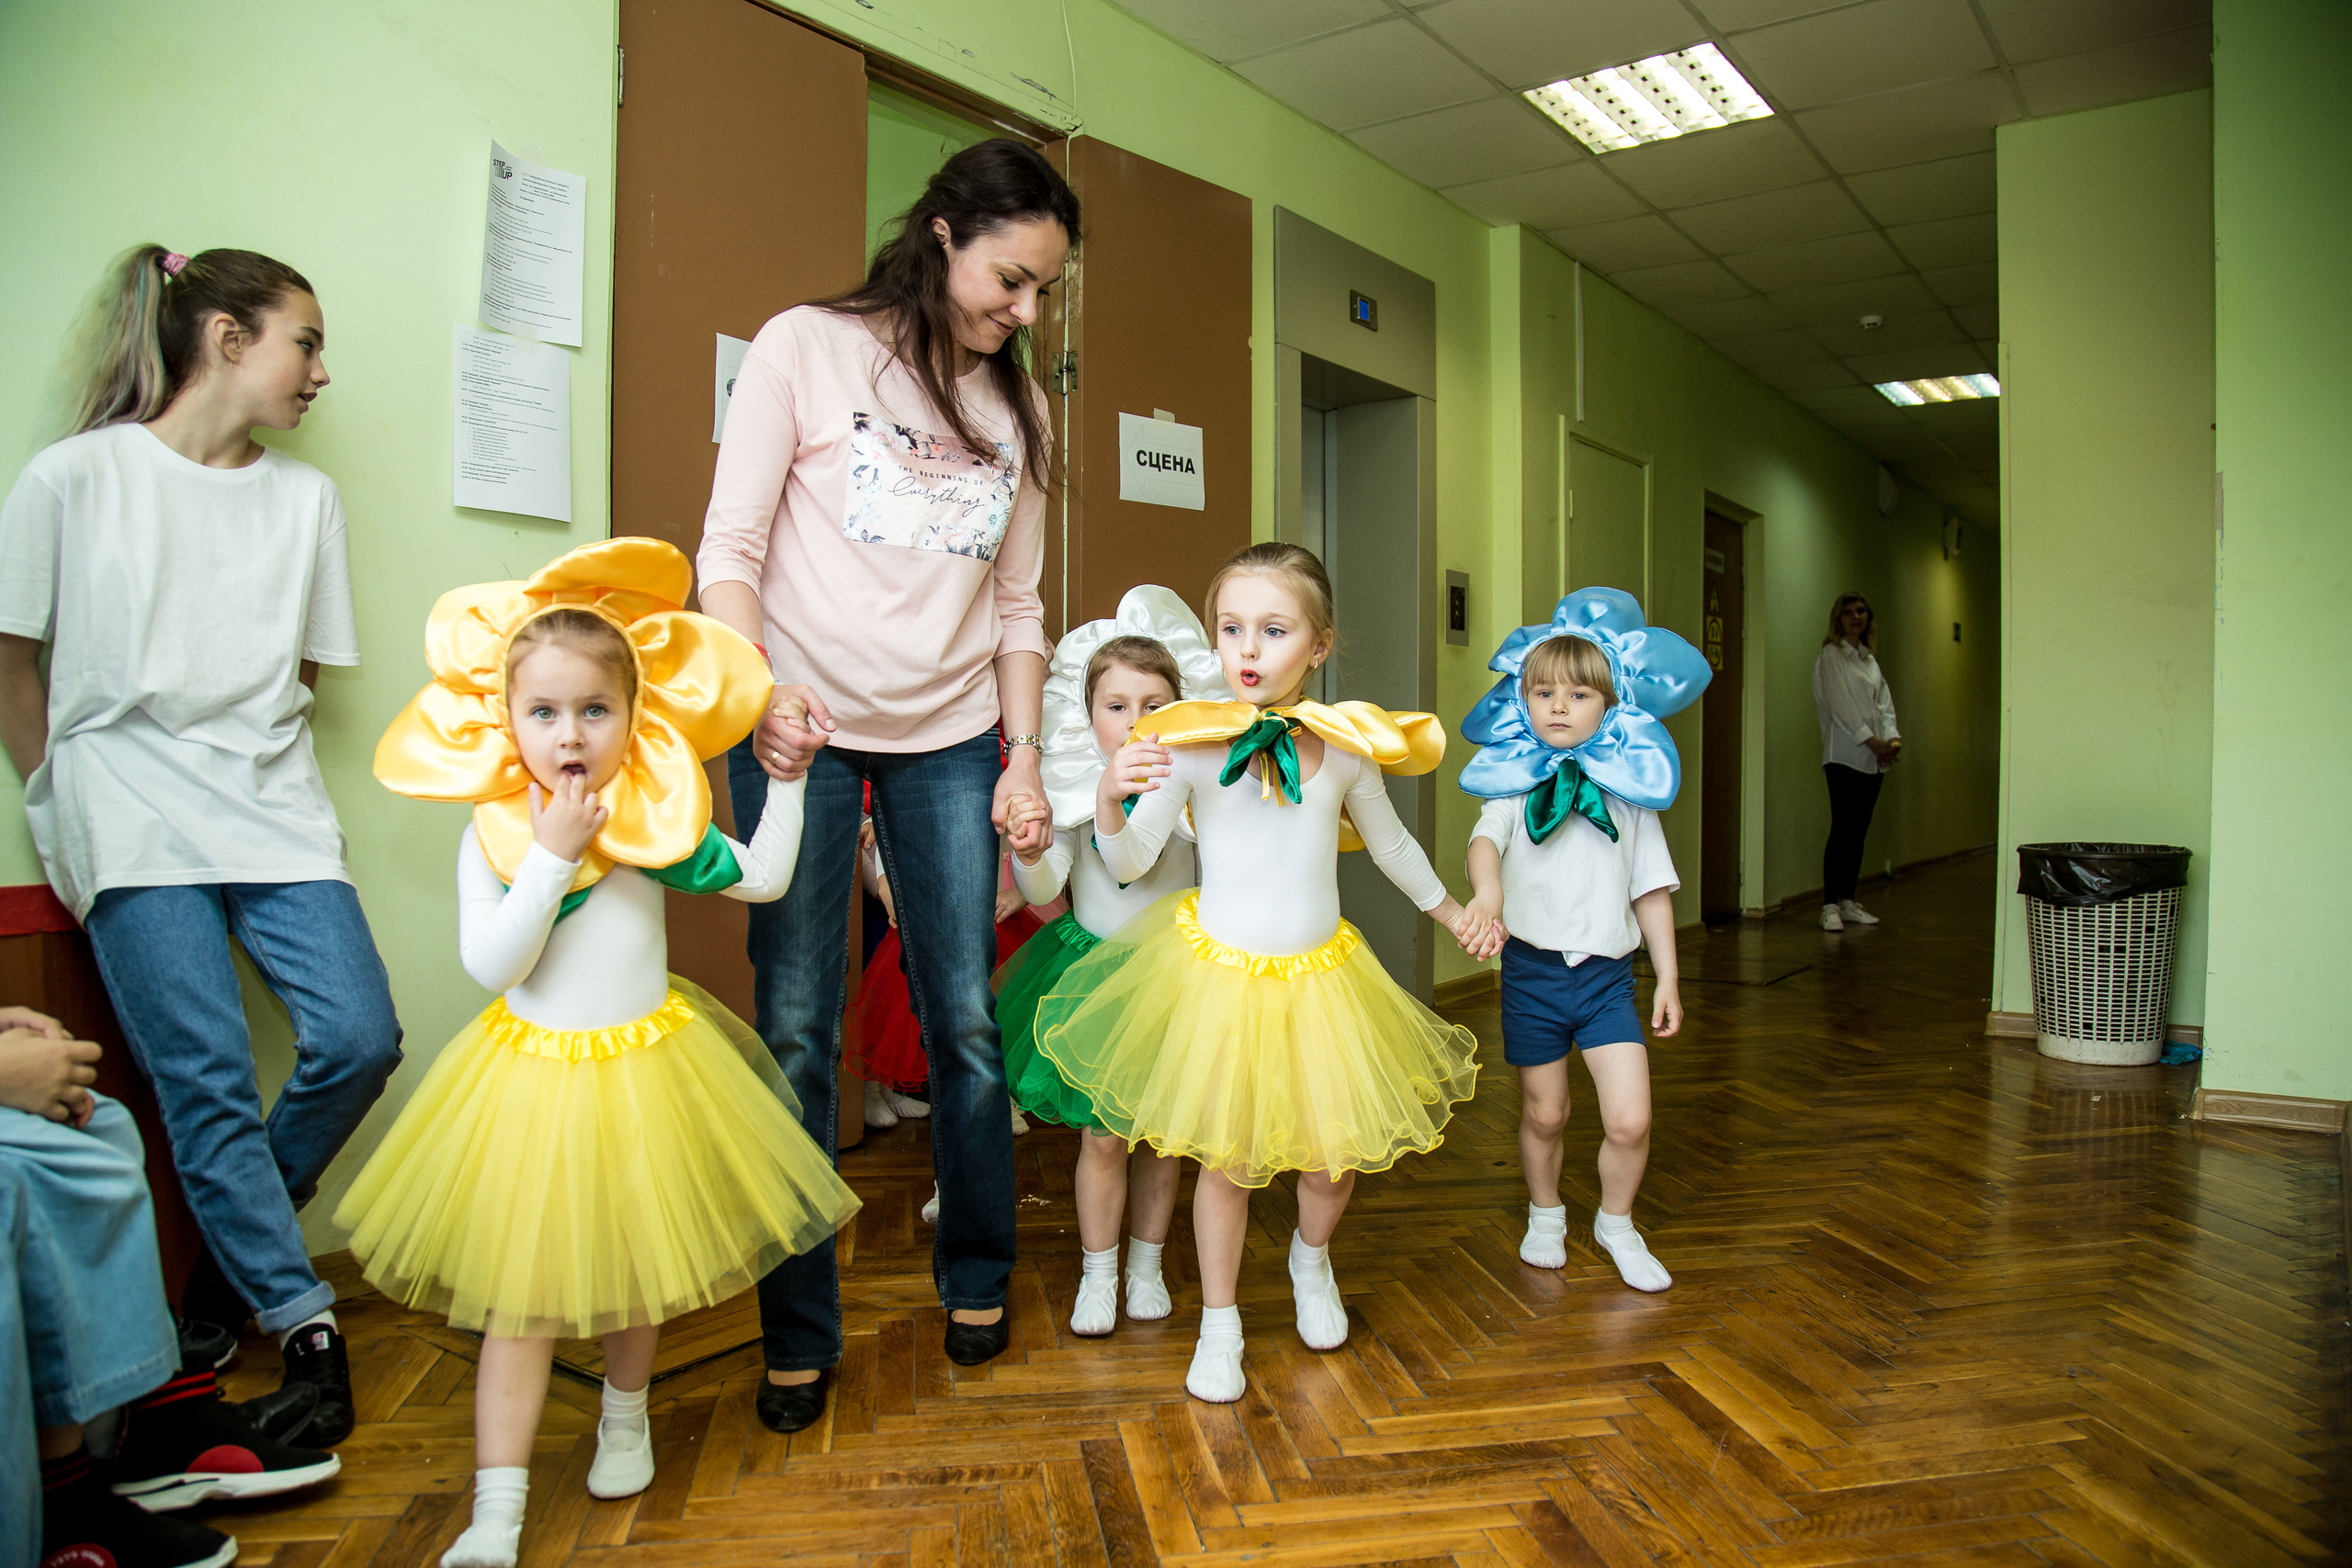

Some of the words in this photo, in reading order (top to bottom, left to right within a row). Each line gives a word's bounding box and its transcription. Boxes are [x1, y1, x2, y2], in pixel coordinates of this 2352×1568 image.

[493, 159, 505, 168] STEP
[502, 170, 513, 180] UP
[1136, 449, 1196, 475] СЦЕНА
[899, 465, 913, 474] THE
[919, 469, 968, 484] BEGINNING
